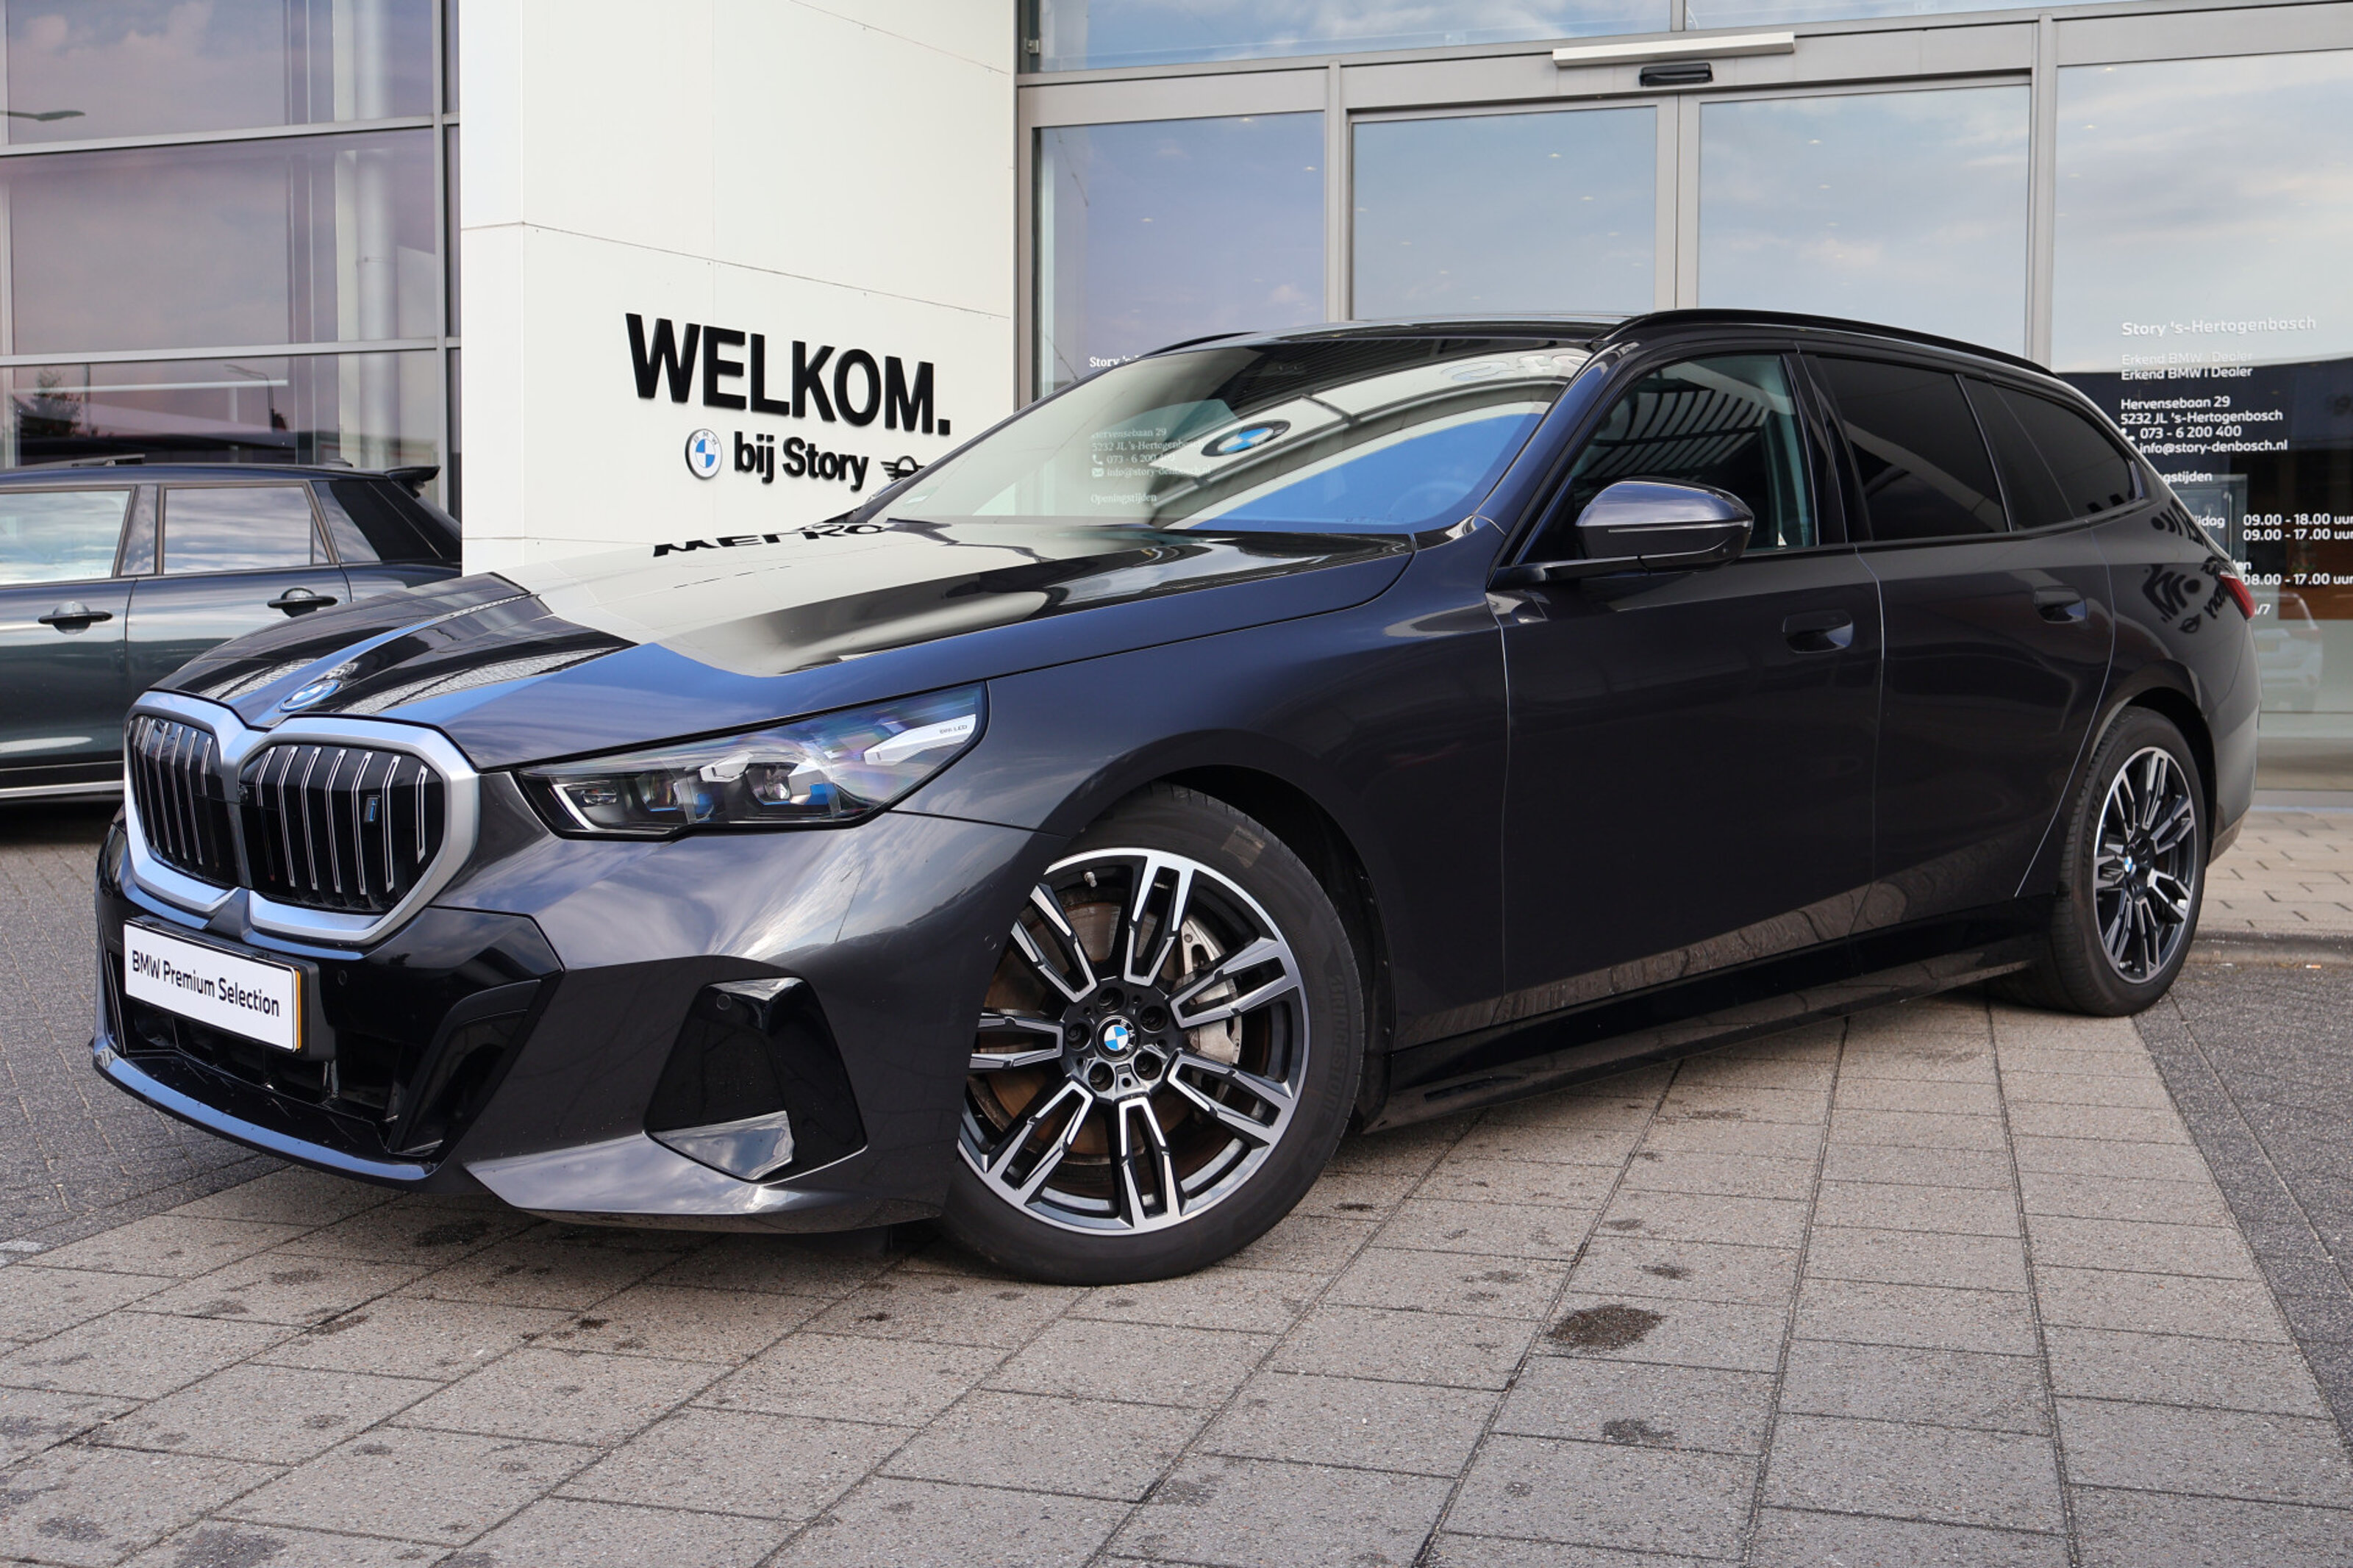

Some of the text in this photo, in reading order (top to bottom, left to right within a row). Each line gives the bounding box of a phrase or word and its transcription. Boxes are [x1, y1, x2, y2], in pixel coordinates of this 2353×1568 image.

[2121, 322, 2166, 337] Story
[2121, 351, 2252, 365] Erkend BMW Dealer
[625, 312, 951, 436] WELKOM.
[2121, 368, 2165, 381] Erkend
[2168, 367, 2202, 379] BMW
[2211, 365, 2254, 378] Dealer
[2121, 395, 2231, 410] Hervensebaan 29
[2121, 412, 2152, 425] 5232
[2153, 412, 2168, 424] JL
[2140, 427, 2163, 440] 073
[2176, 426, 2185, 438] 6
[2187, 426, 2213, 438] 200
[2215, 425, 2242, 437] 400
[2139, 440, 2288, 456] info@story-denbosch.nl
[734, 431, 869, 492] bij Story
[2243, 514, 2282, 526] 09.00
[2293, 513, 2331, 526] 18.00
[2243, 529, 2282, 541] 09.00
[2243, 573, 2282, 585] 08.00
[132, 950, 279, 1017] BMW Premium Selection
